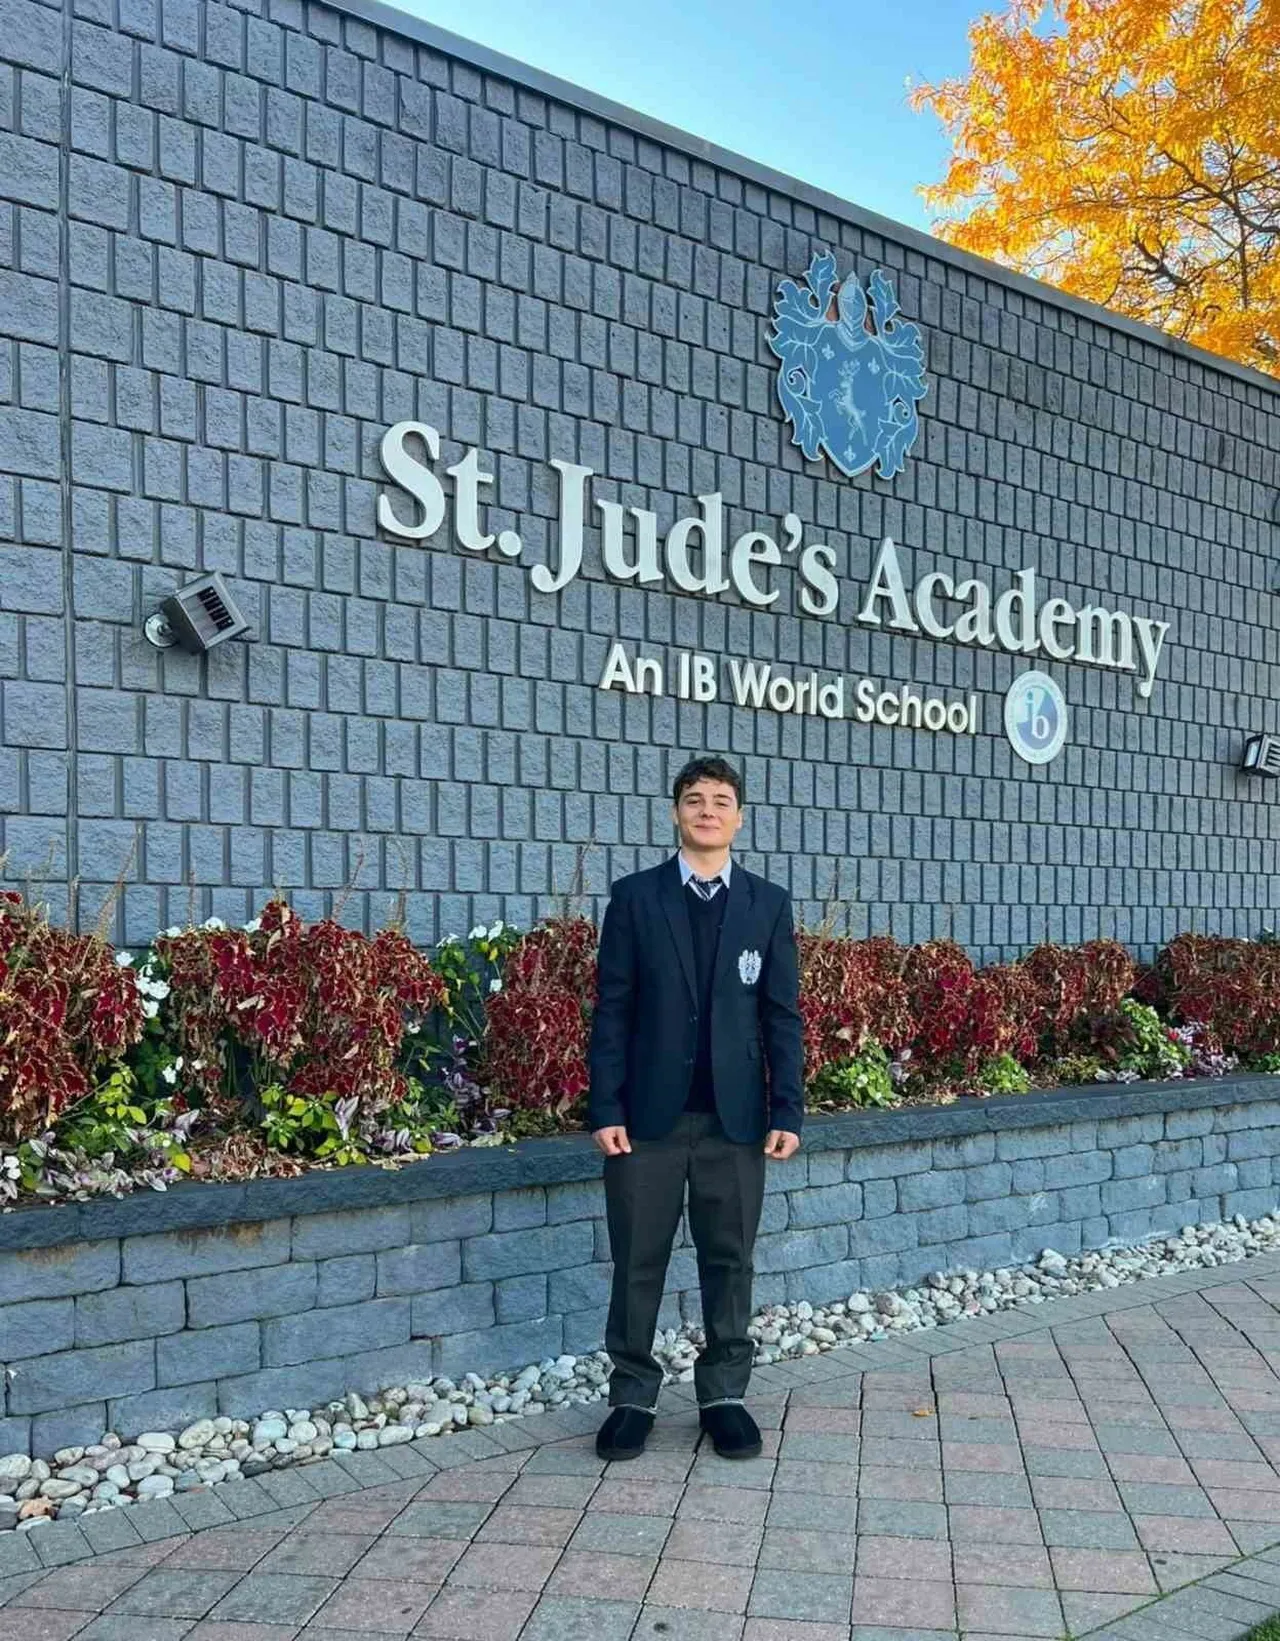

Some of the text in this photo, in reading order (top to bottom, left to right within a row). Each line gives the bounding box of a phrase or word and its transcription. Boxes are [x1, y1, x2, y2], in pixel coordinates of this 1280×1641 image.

[376, 420, 1171, 698] St. Jude's Academy
[598, 642, 664, 696] An
[678, 652, 718, 702] IB
[729, 659, 844, 719] World
[856, 676, 977, 734] School
